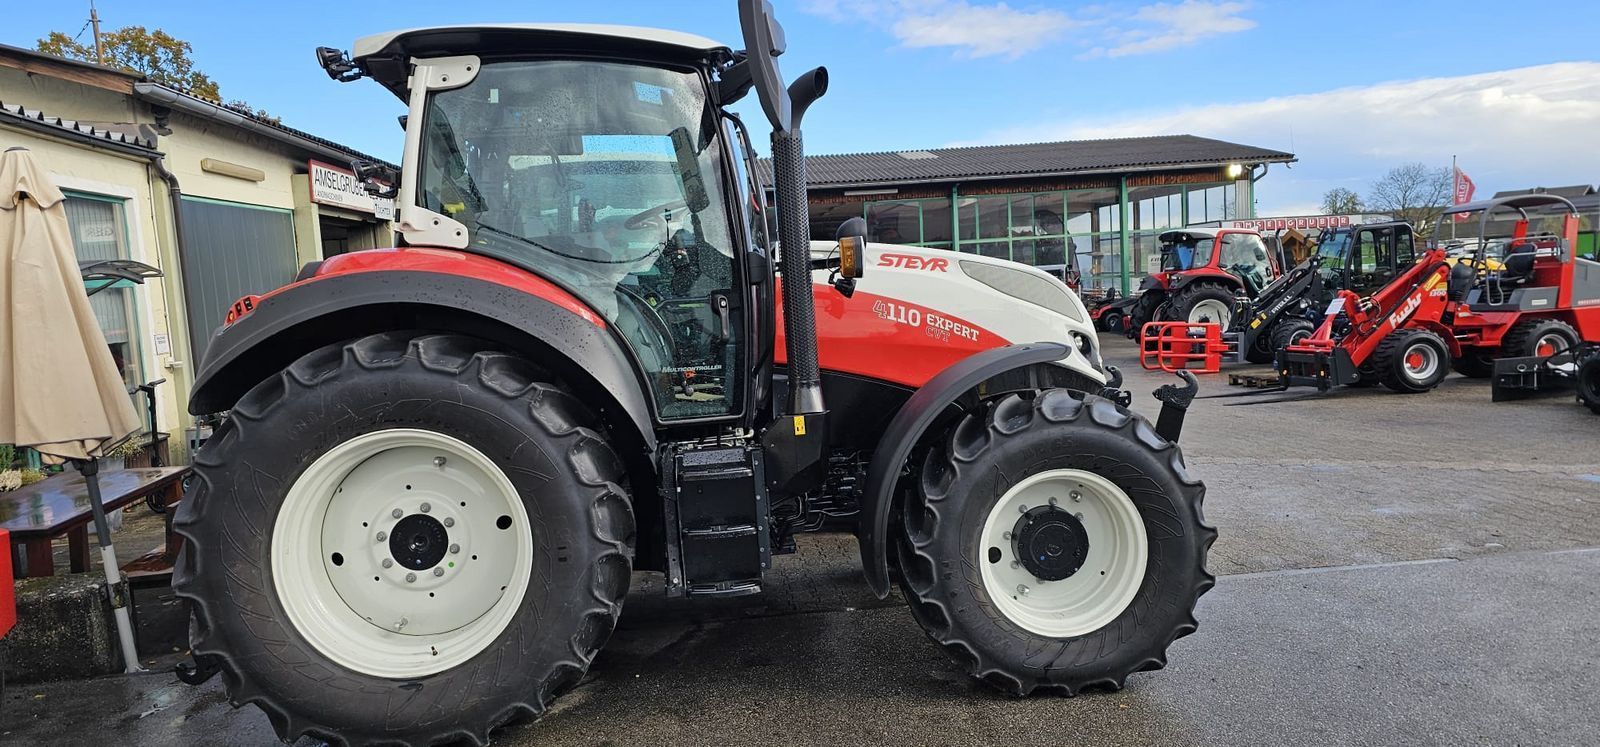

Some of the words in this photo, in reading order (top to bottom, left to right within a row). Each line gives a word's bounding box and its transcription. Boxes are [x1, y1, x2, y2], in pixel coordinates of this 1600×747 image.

[1235, 216, 1350, 230] AMSELGRUBER
[877, 253, 949, 273] STEYR
[1271, 295, 1292, 314] PITBULL
[1388, 292, 1421, 329] Fuchs
[873, 300, 921, 327] 4110
[926, 313, 979, 341] EXPERT
[925, 326, 951, 343] CVT
[661, 364, 722, 374] MULTICONTROLLER
